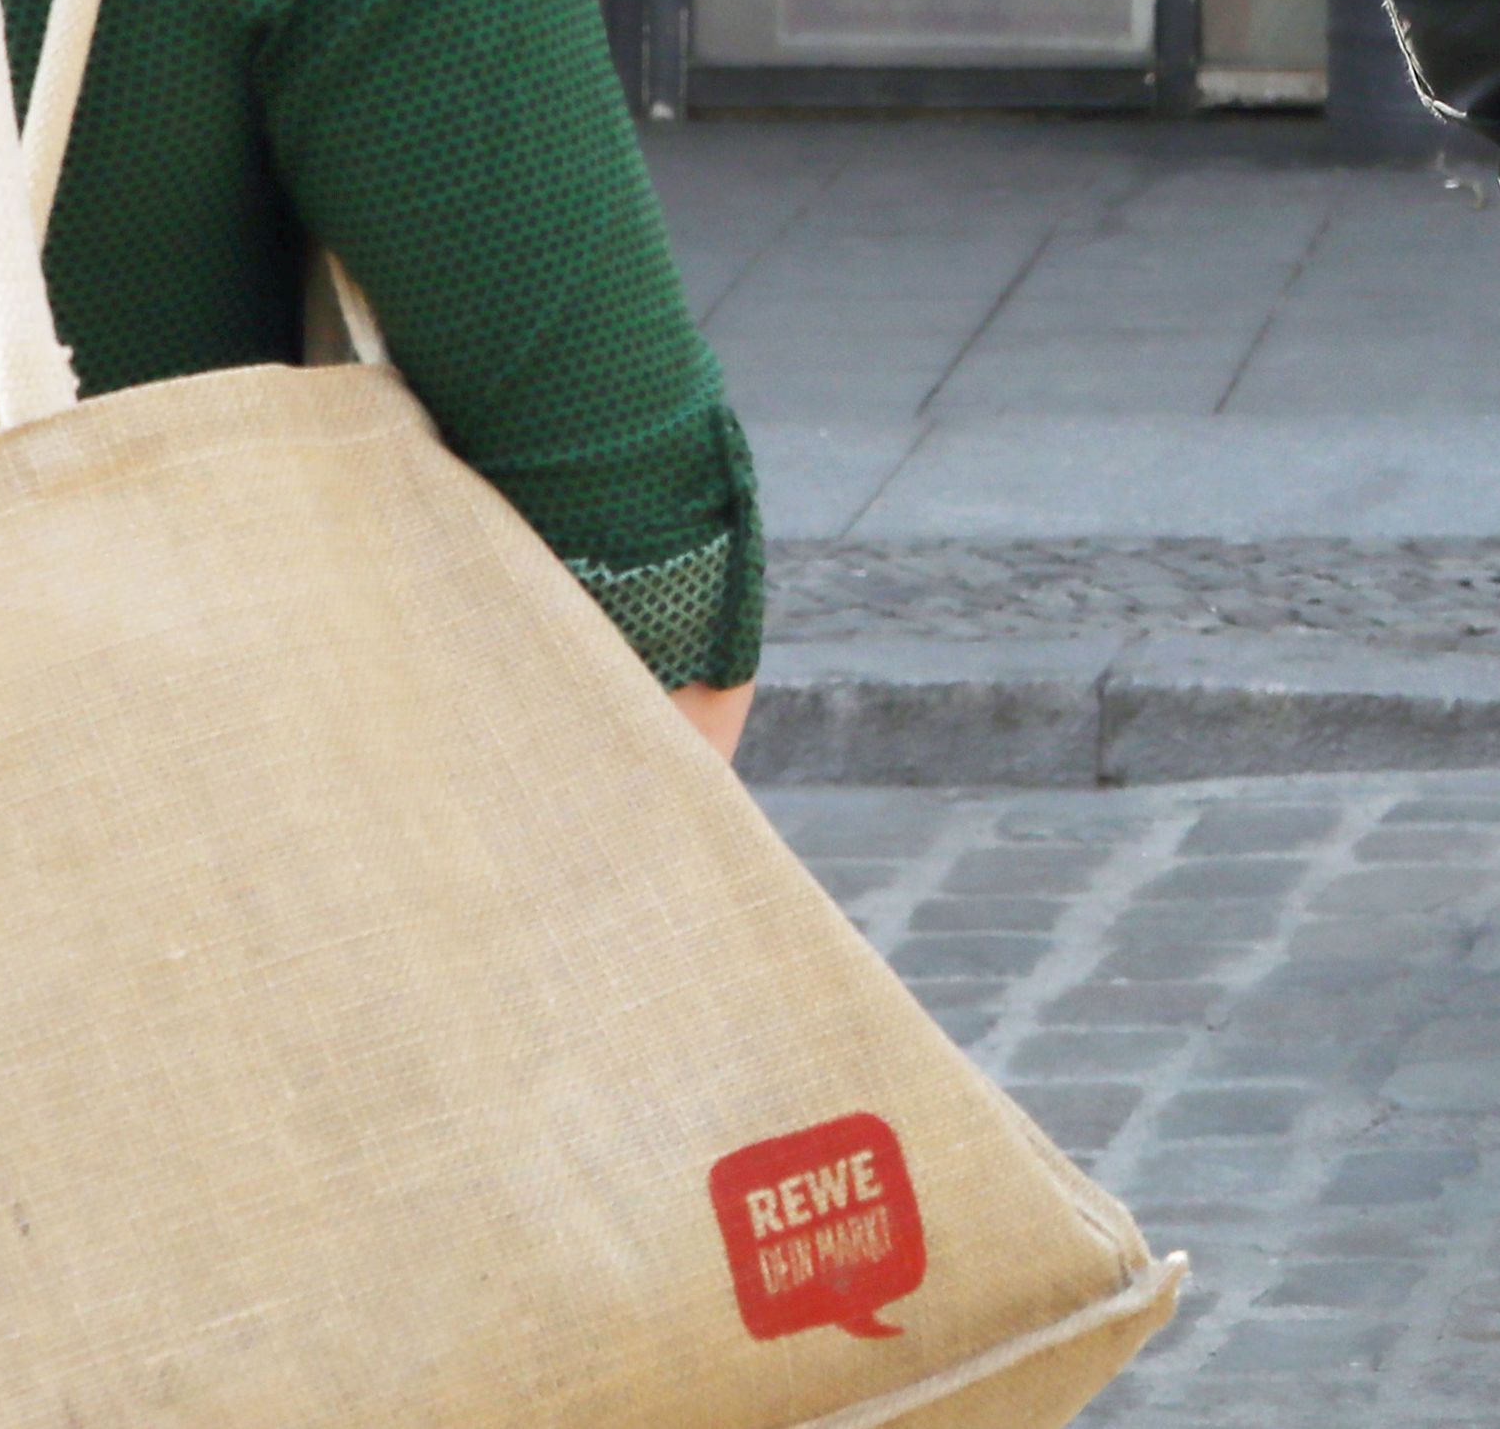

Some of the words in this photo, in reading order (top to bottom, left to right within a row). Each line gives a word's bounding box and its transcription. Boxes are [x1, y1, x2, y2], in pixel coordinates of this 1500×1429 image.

[745, 1149, 884, 1240] REWE
[757, 1239, 816, 1295] DEIN
[814, 1205, 894, 1274] MARKT
